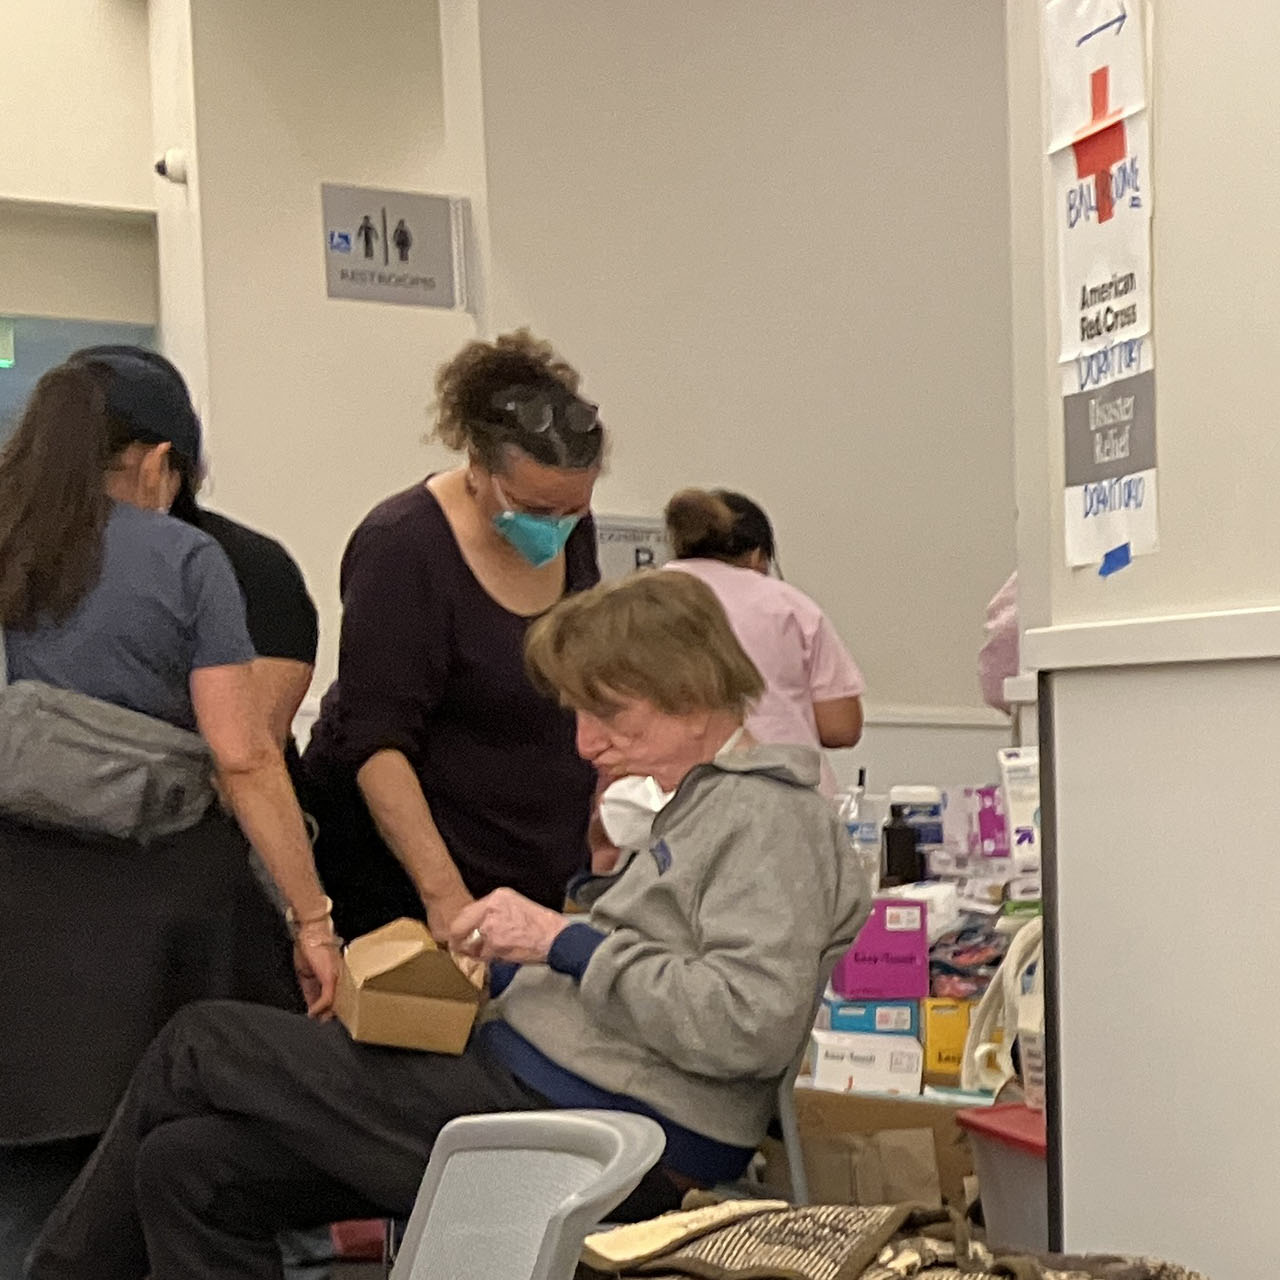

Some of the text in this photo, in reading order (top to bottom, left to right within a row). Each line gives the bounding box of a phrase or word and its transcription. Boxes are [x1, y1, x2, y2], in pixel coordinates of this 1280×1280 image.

[340, 269, 436, 291] RESTROOMS
[1080, 272, 1137, 311] American
[1080, 303, 1137, 342] Red Cross
[1088, 395, 1136, 431] Disaster
[1094, 424, 1132, 465] Relief
